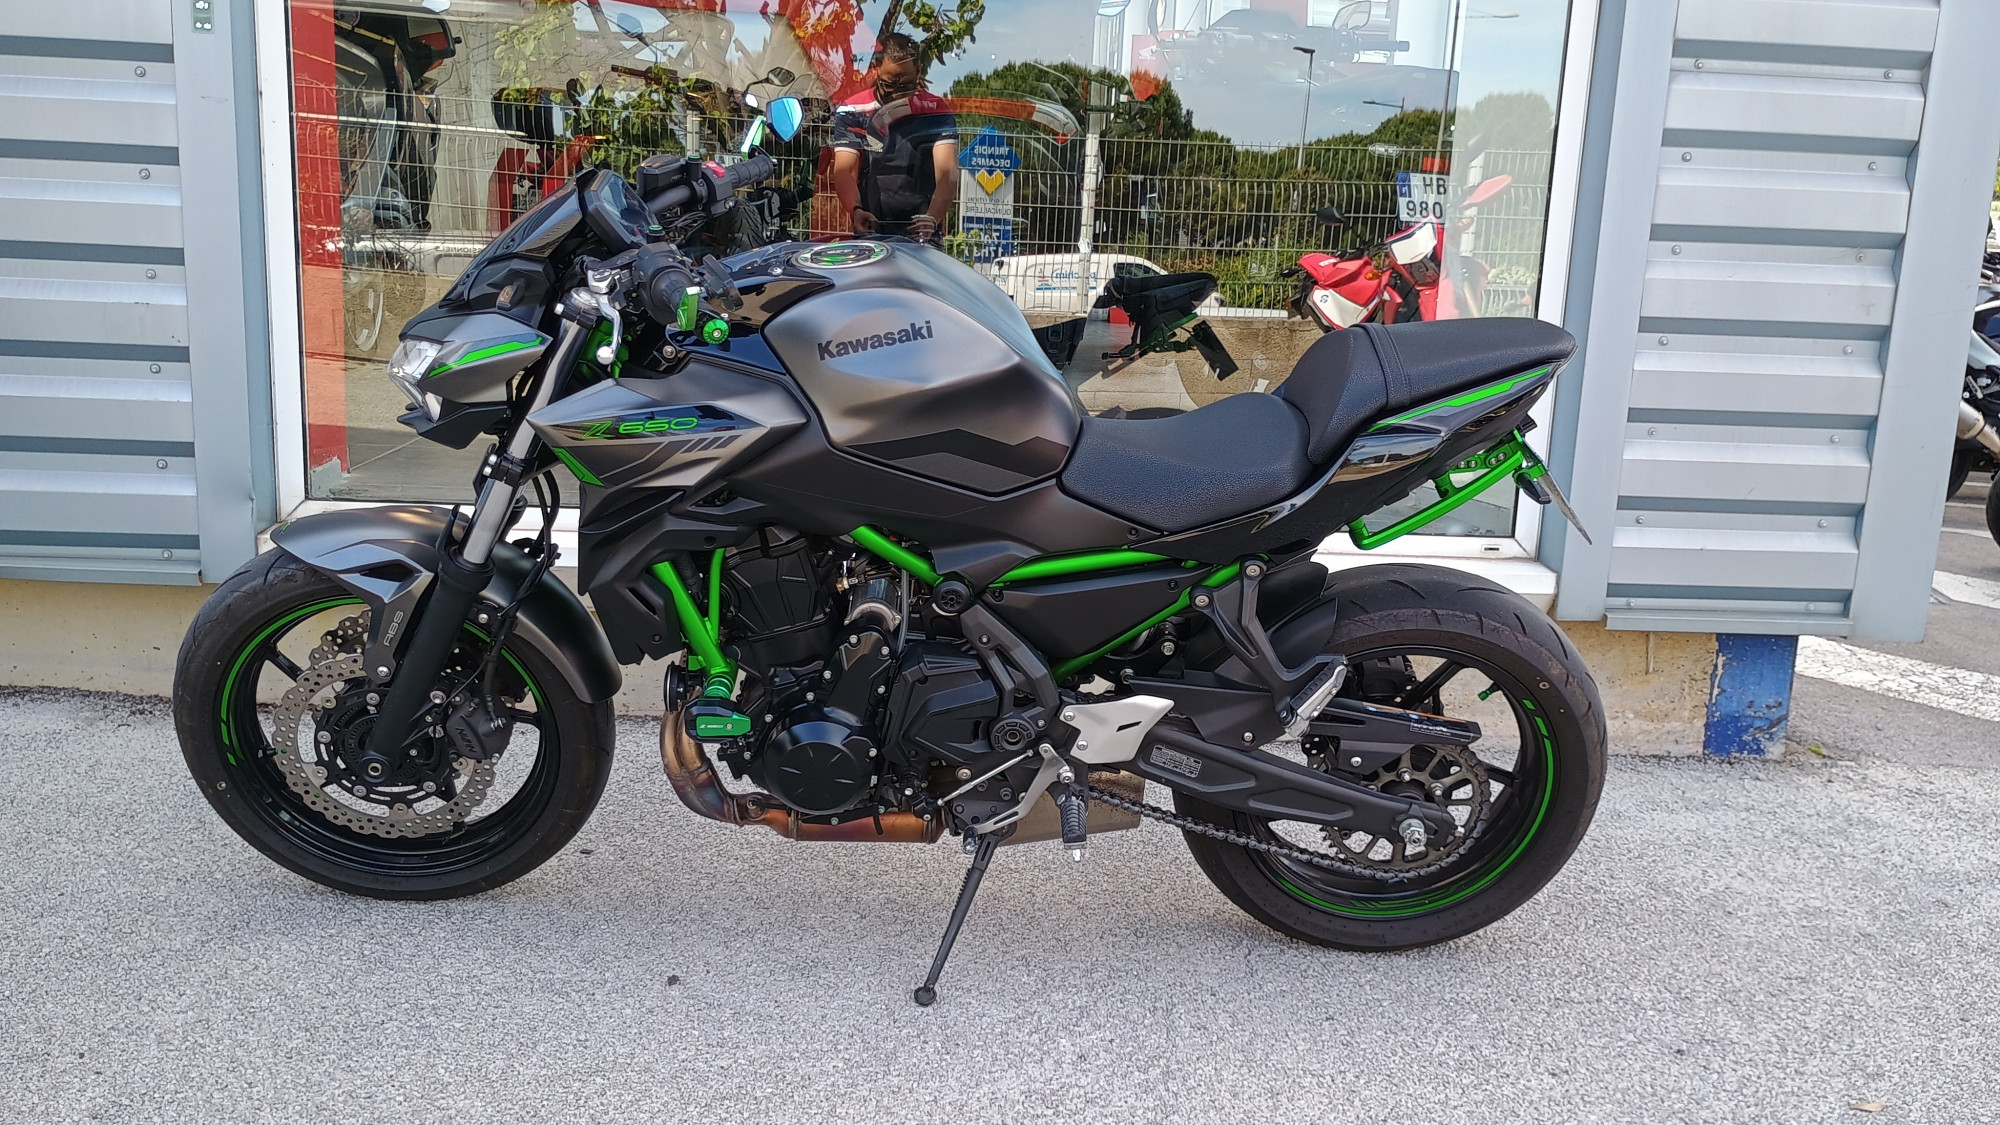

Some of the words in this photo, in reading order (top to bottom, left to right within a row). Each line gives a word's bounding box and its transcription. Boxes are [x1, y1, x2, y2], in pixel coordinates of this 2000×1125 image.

[1422, 176, 1447, 195] HB
[1406, 200, 1443, 219] 980
[817, 320, 934, 361] Kawasaki
[580, 420, 617, 440] Z
[618, 416, 699, 434] 650
[383, 610, 404, 646] ABS
